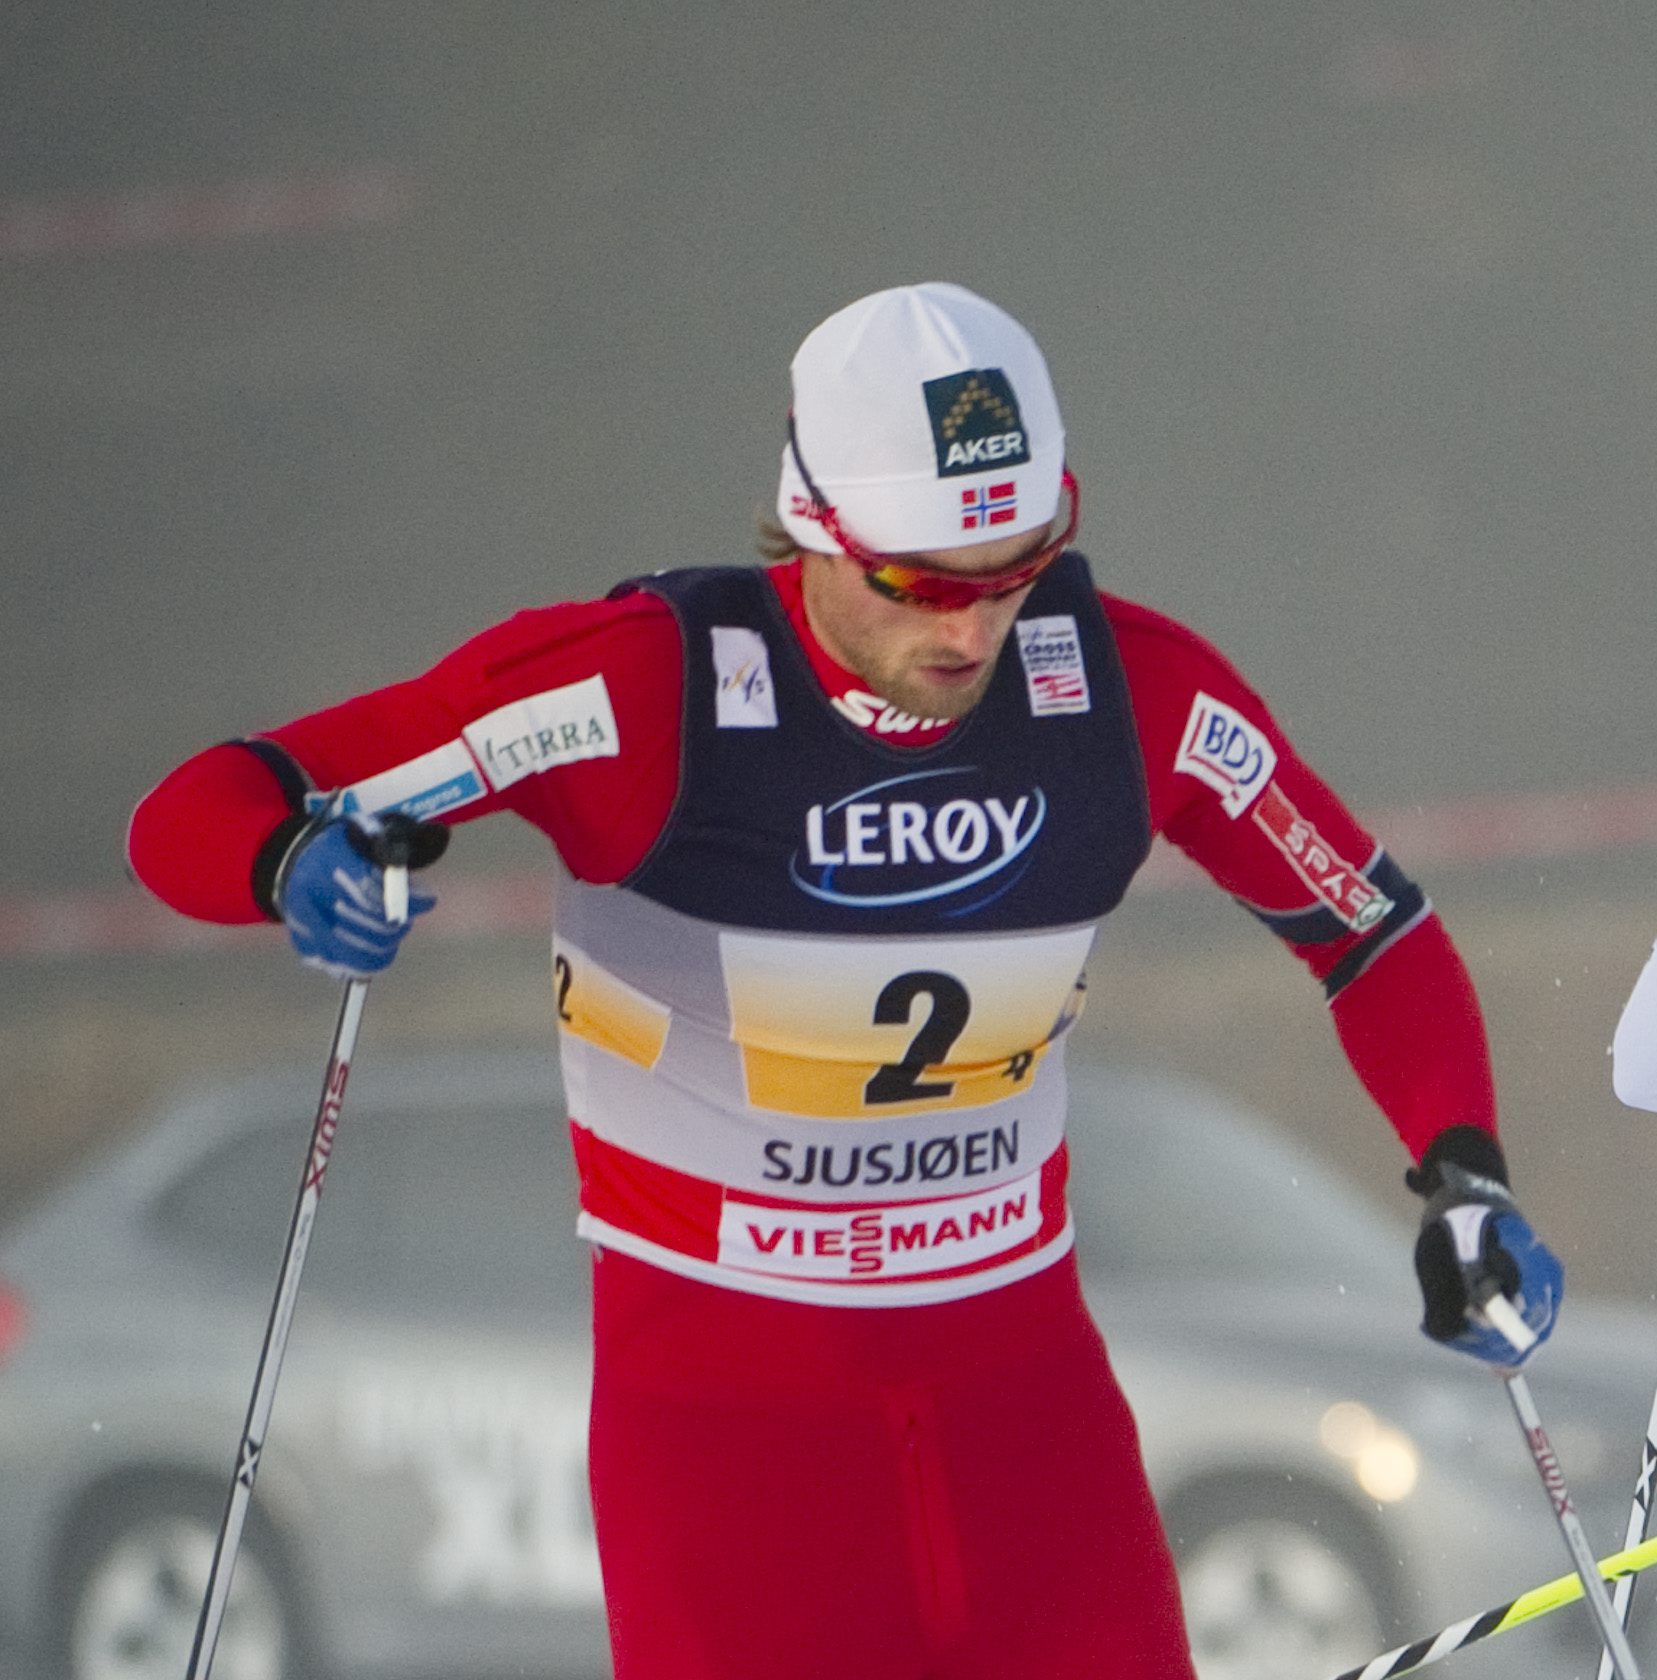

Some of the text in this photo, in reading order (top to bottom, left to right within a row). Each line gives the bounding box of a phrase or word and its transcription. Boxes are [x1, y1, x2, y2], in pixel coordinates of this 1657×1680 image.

[944, 431, 1024, 469] AKER
[831, 688, 951, 734] Sw
[805, 796, 1030, 866] LERØY
[864, 969, 972, 1107] 2
[762, 1120, 1021, 1188] SJUSJØEN
[746, 1192, 1029, 1276] VIESSMANN
